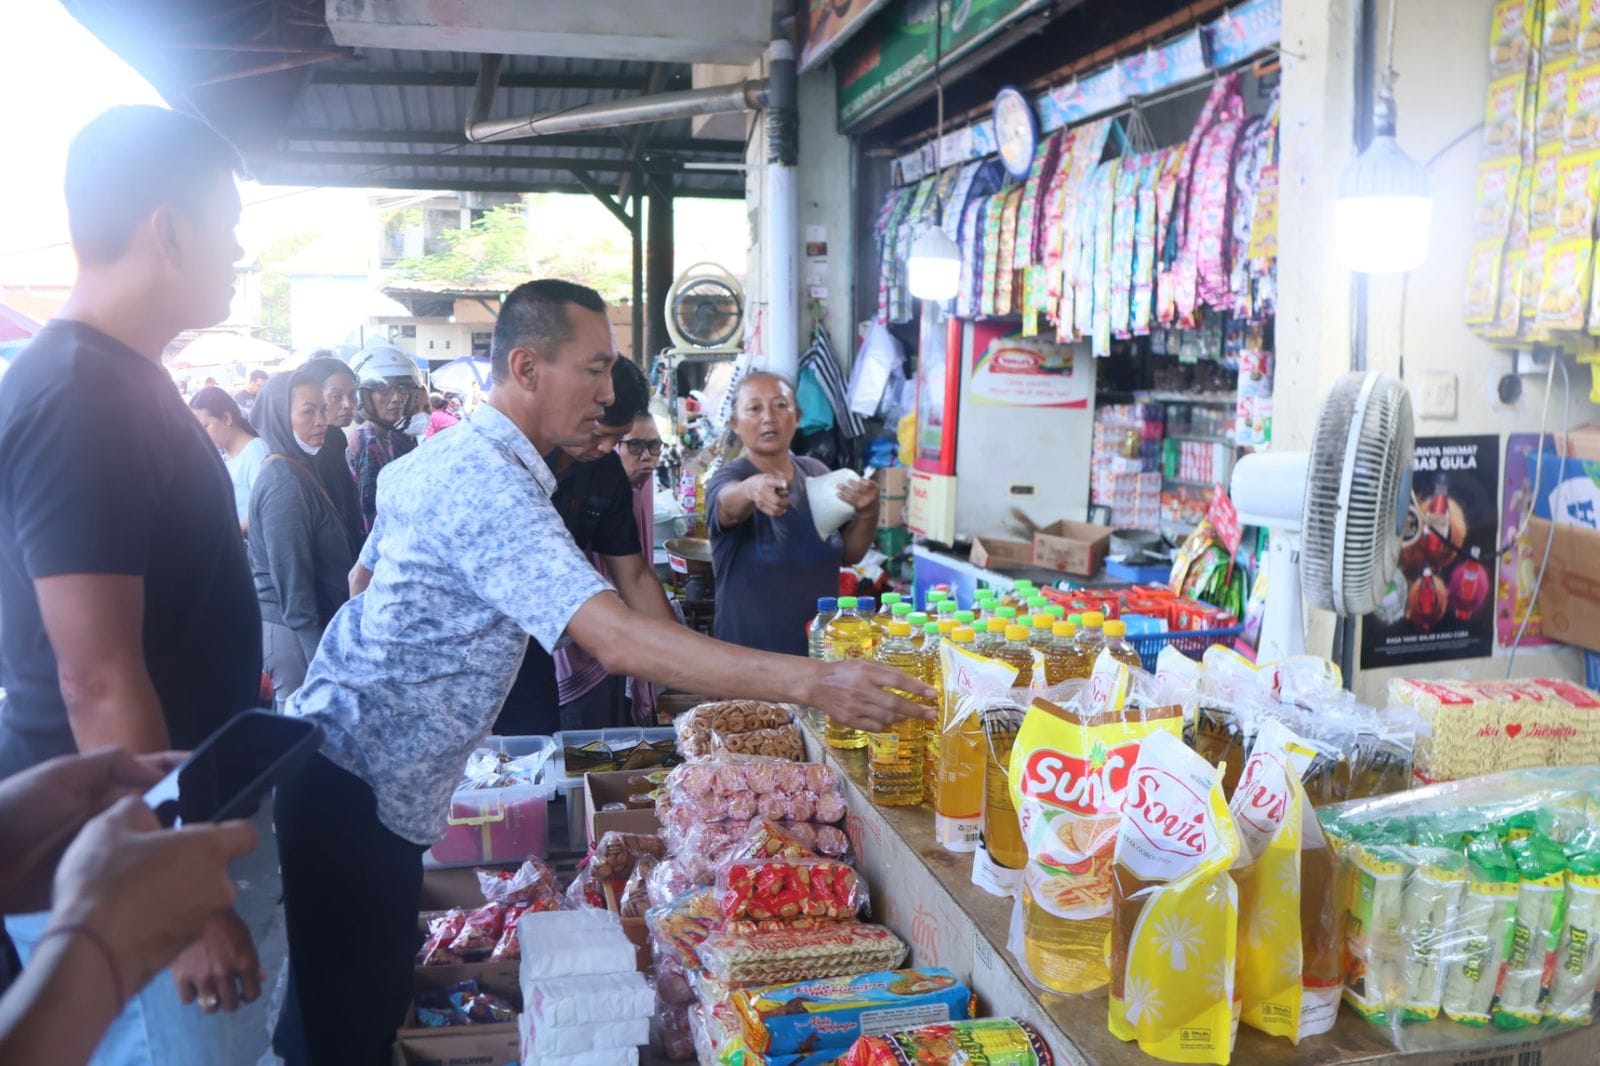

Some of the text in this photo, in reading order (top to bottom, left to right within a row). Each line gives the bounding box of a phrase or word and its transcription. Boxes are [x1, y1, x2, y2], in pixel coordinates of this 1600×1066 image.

[1411, 454, 1477, 471] BAS GULA
[1442, 444, 1478, 456] NIKMAT
[1028, 754, 1129, 810] SunC
[1129, 775, 1206, 853] Sovia
